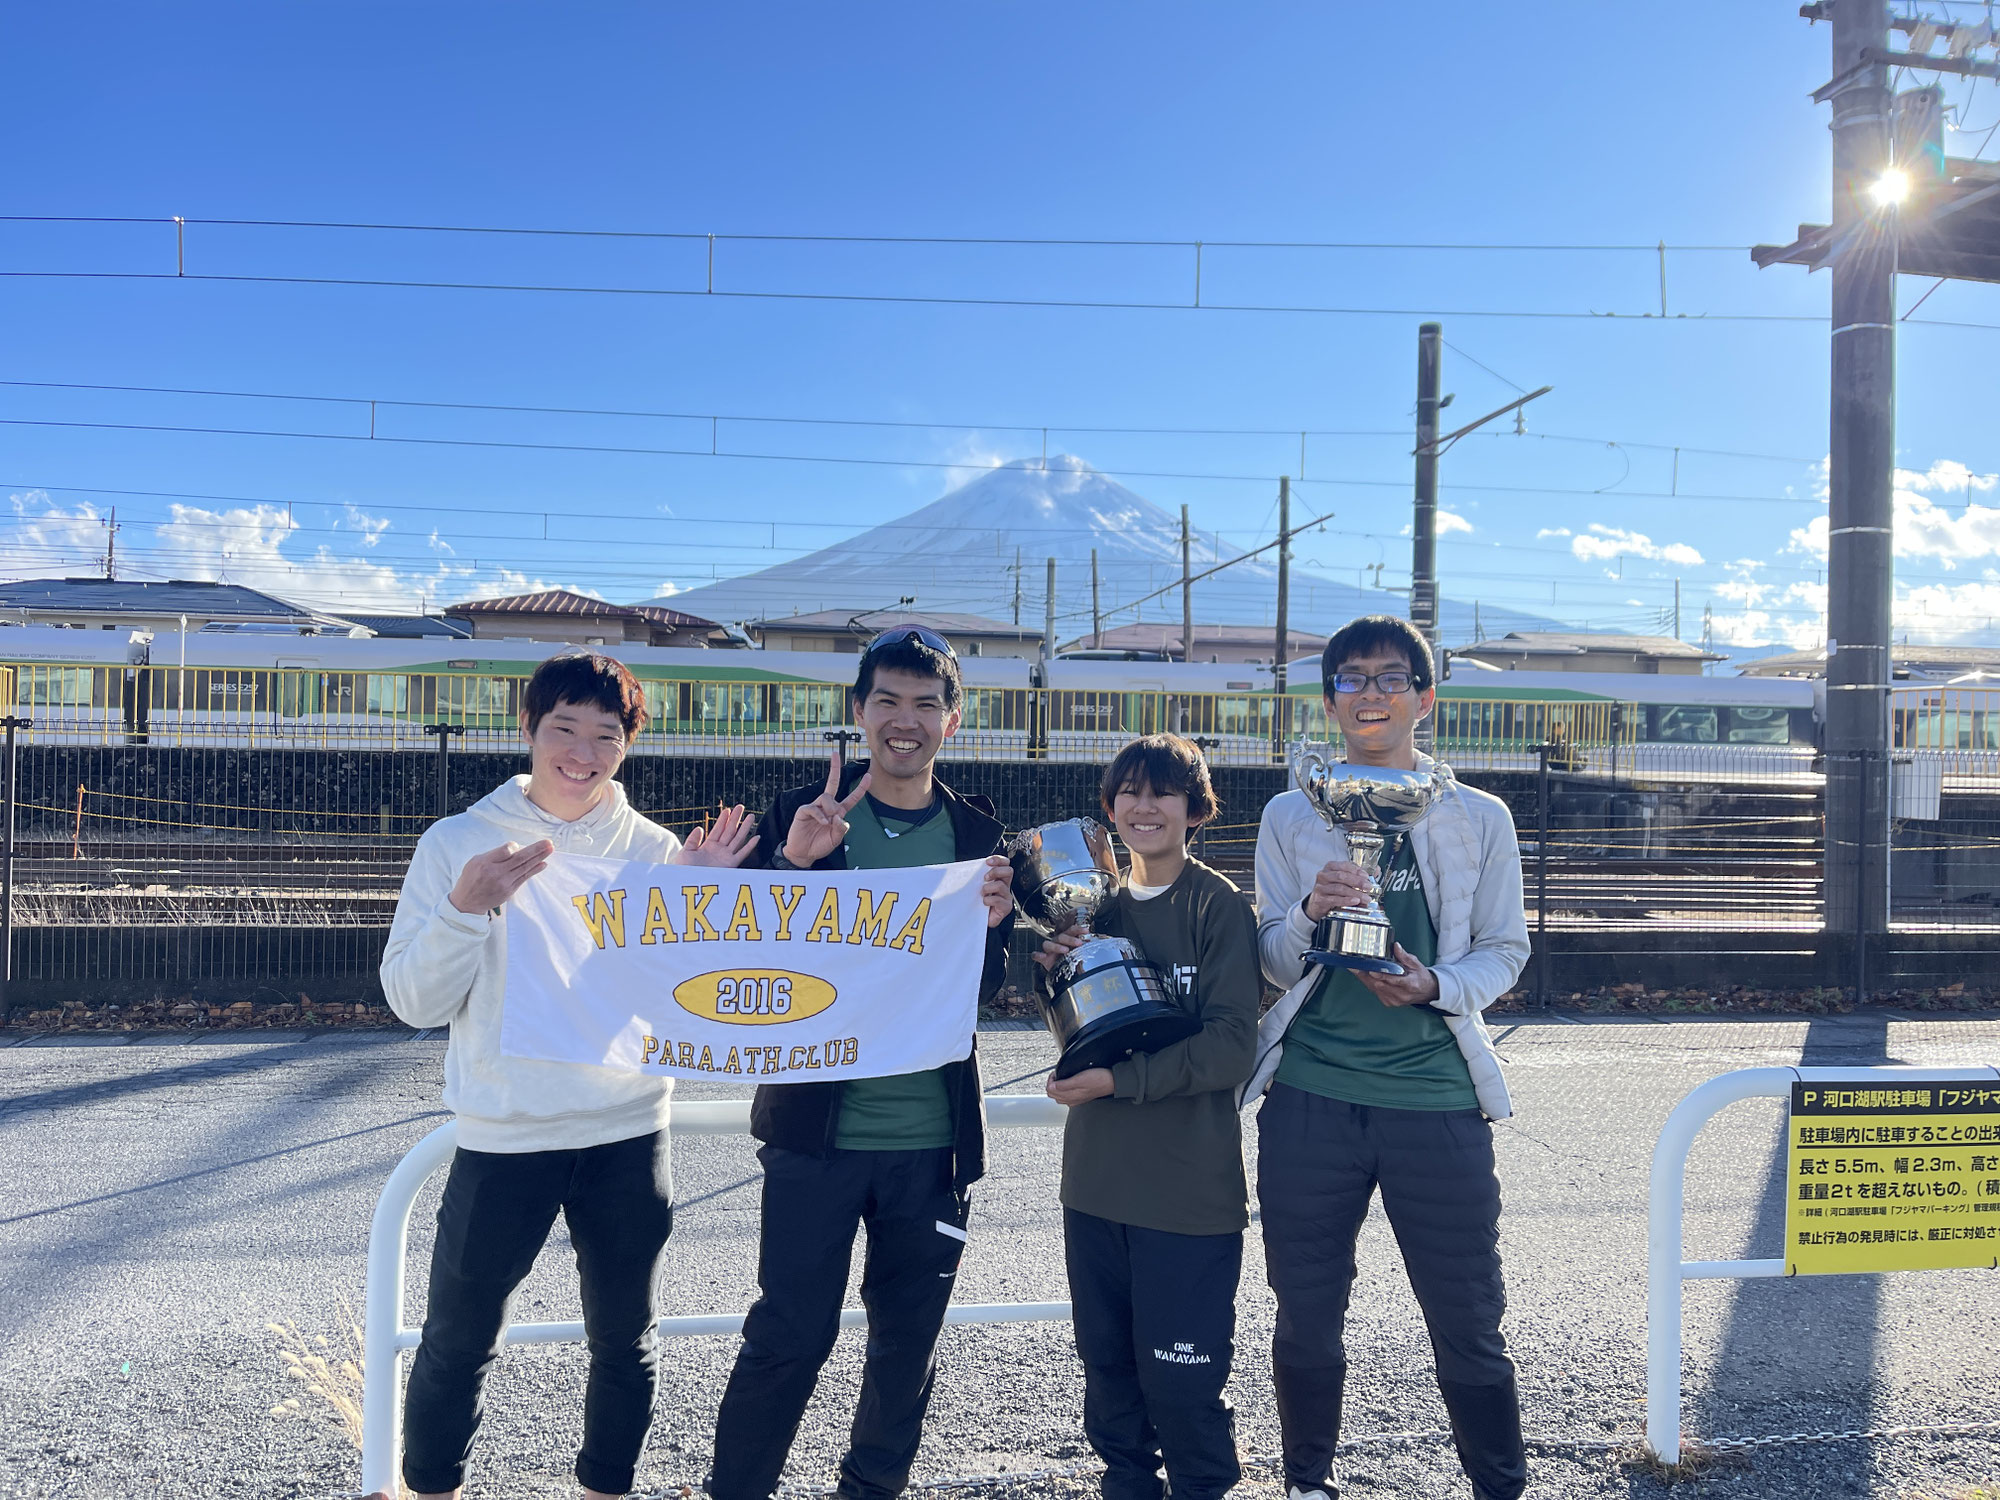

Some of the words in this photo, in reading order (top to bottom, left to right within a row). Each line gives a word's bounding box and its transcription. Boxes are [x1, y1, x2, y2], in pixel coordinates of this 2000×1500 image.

[209, 683, 237, 692] SERES
[333, 686, 352, 696] JR
[572, 884, 932, 955] WAKAYAMA
[716, 977, 793, 1015] 2016
[641, 1035, 859, 1075] PARA.ATH.CLUB
[1803, 1091, 1817, 1106] P
[1798, 1226, 2000, 1245] 禁止行為の発見時には、厳正に対処さ
[1174, 1342, 1195, 1353] ONE
[1154, 1348, 1211, 1364] WAKAYAMA
